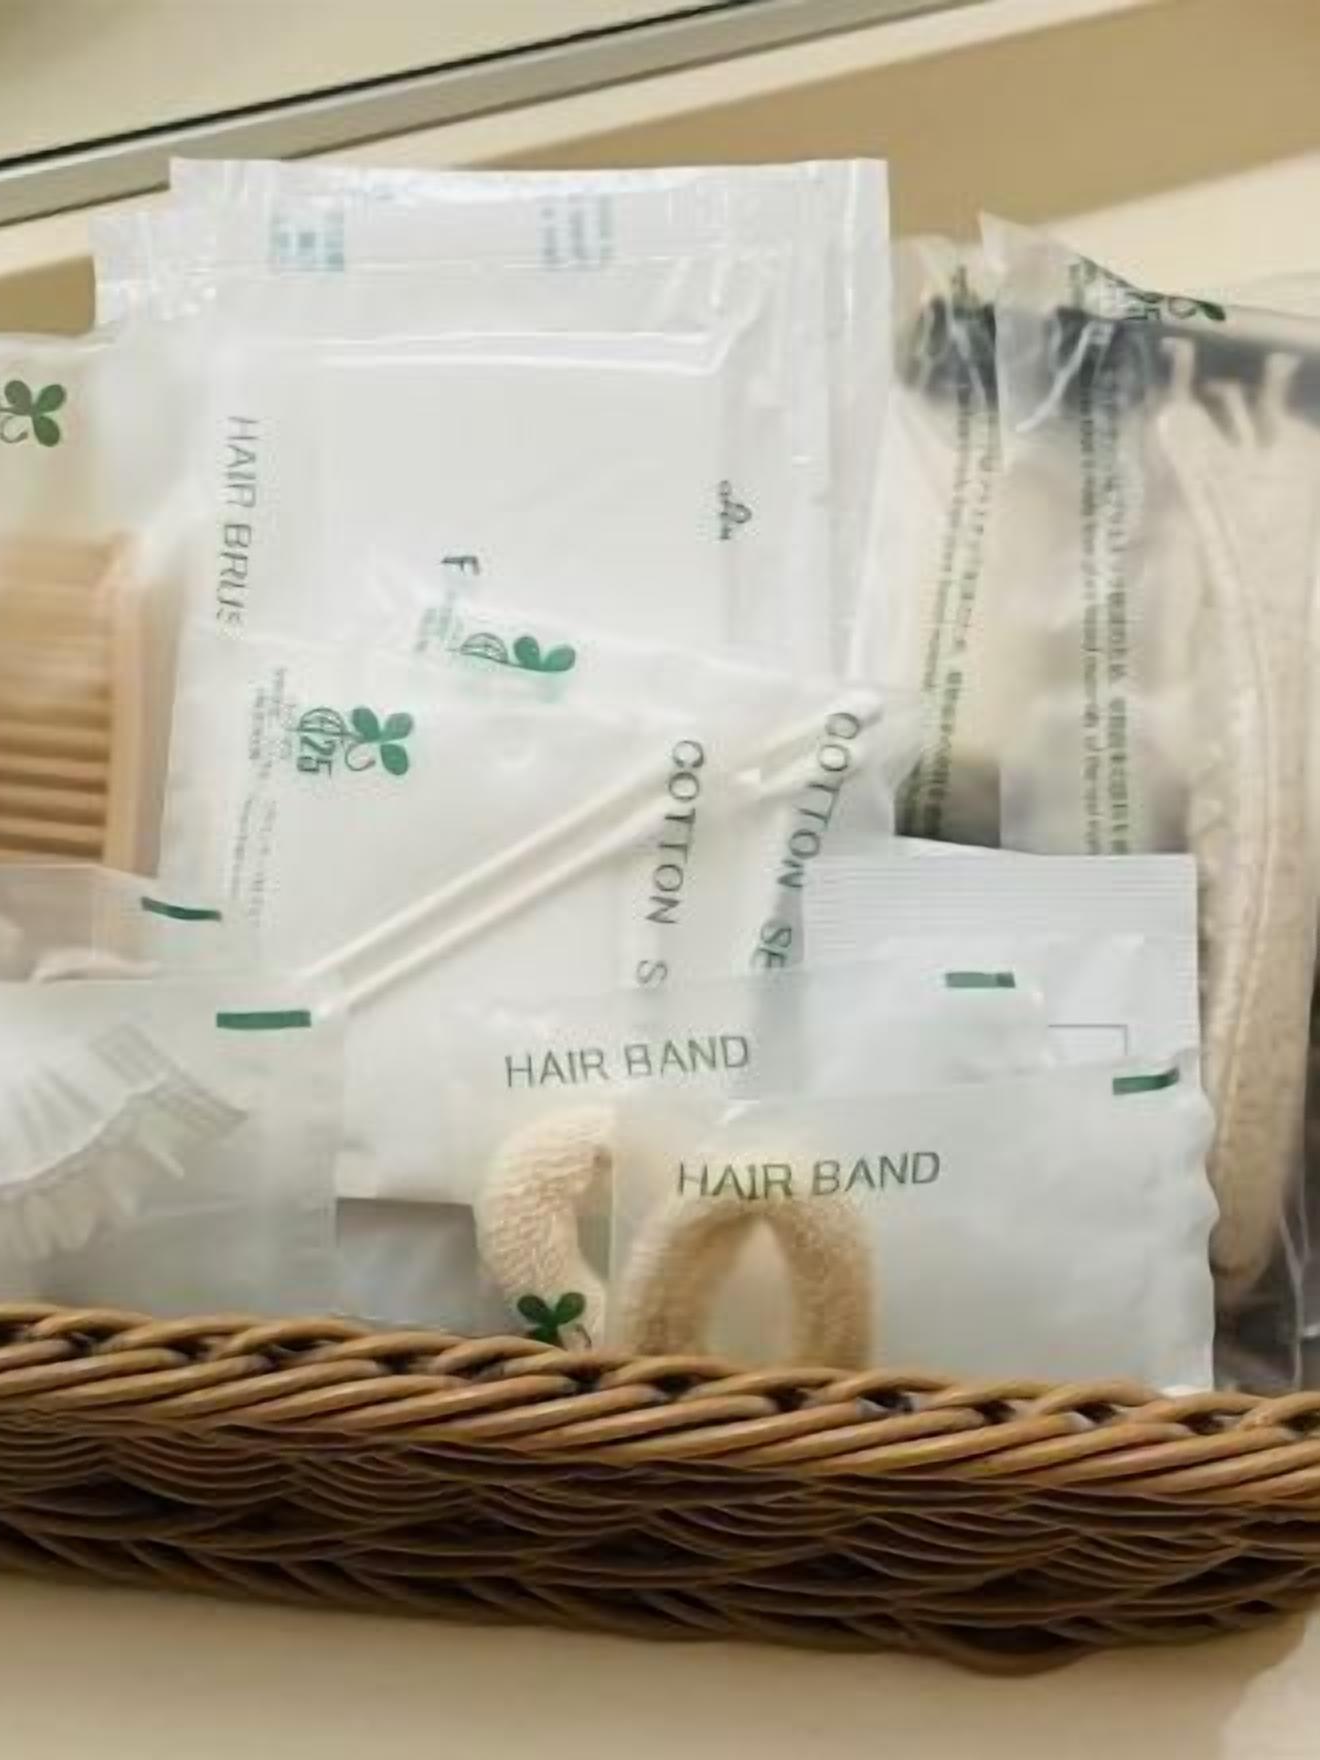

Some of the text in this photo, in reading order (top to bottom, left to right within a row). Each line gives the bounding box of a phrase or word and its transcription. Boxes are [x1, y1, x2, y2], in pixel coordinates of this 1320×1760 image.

[226, 415, 259, 508] HAIR
[777, 712, 861, 890] COTTON
[636, 740, 705, 985] COTTON S
[503, 1034, 751, 1088] HAIR BAND
[679, 1150, 942, 1201] HAIR BAND
